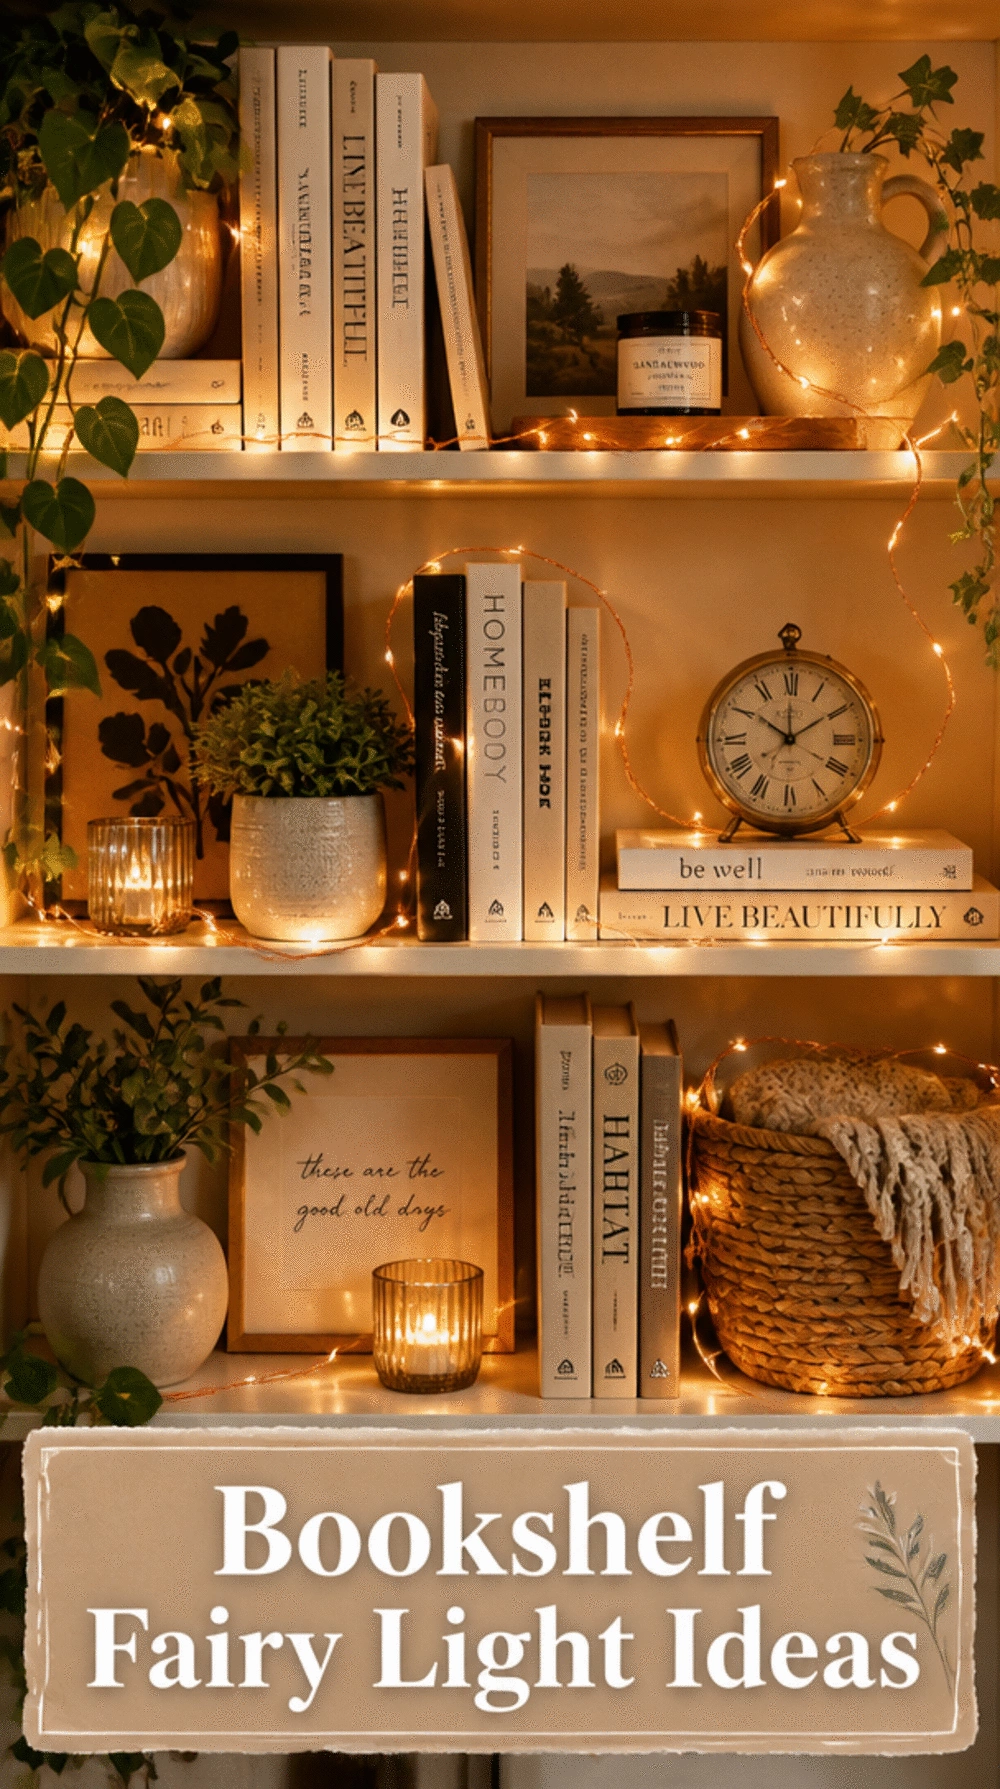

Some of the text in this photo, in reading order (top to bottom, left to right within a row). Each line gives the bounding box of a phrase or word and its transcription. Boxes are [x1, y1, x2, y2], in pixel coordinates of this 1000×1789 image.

[482, 594, 507, 784] HOMEBODY
[680, 857, 762, 879] be well
[662, 905, 947, 929] LIVE BEAUTIFULLY
[297, 1153, 445, 1179] these are the
[294, 1194, 345, 1232] good
[354, 1194, 388, 1217] old
